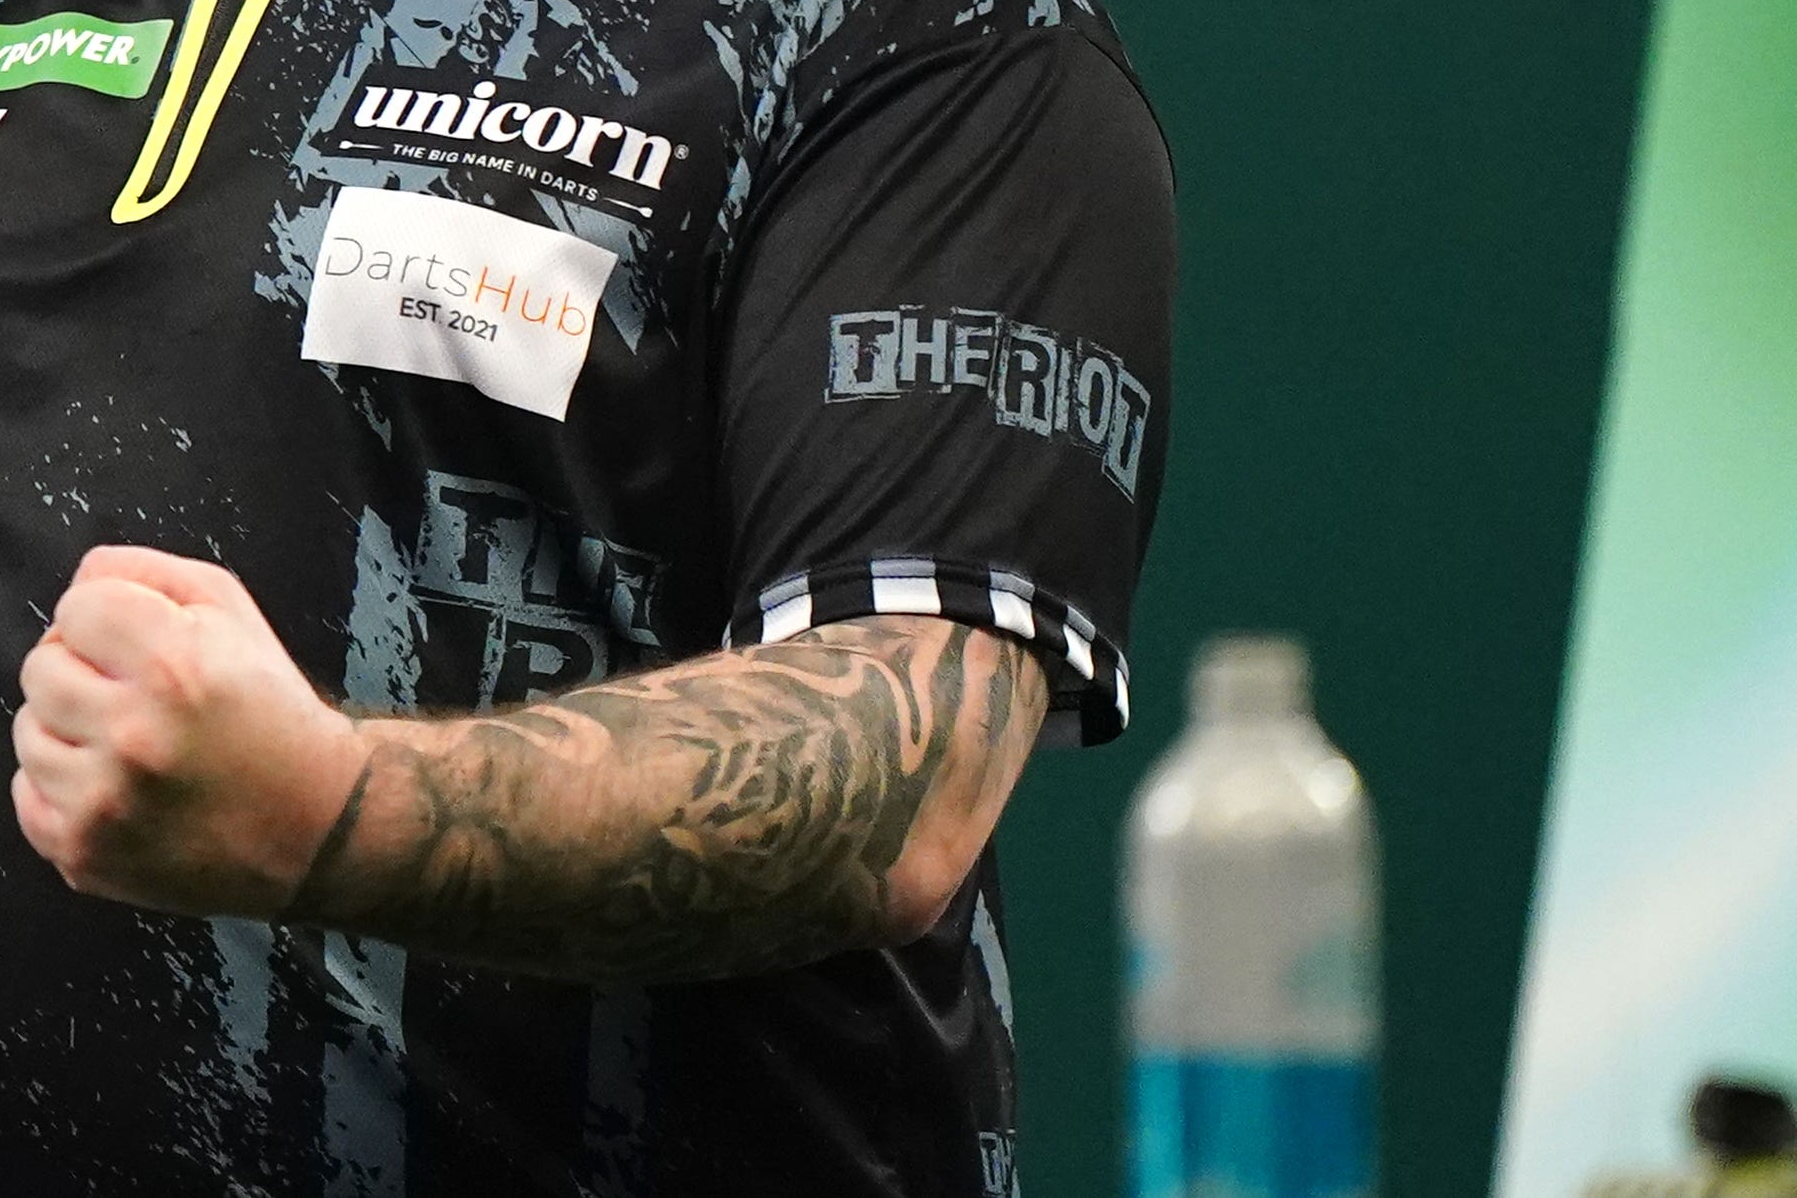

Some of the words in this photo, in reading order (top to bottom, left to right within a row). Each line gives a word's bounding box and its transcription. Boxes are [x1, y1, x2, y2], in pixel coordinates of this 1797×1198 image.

[392, 143, 426, 160] THE
[427, 148, 459, 164] BIG
[461, 152, 515, 174] NAME
[517, 162, 538, 180] IN
[539, 171, 600, 202] DARTS
[324, 236, 587, 336] DartsHub
[447, 309, 499, 342] 2021
